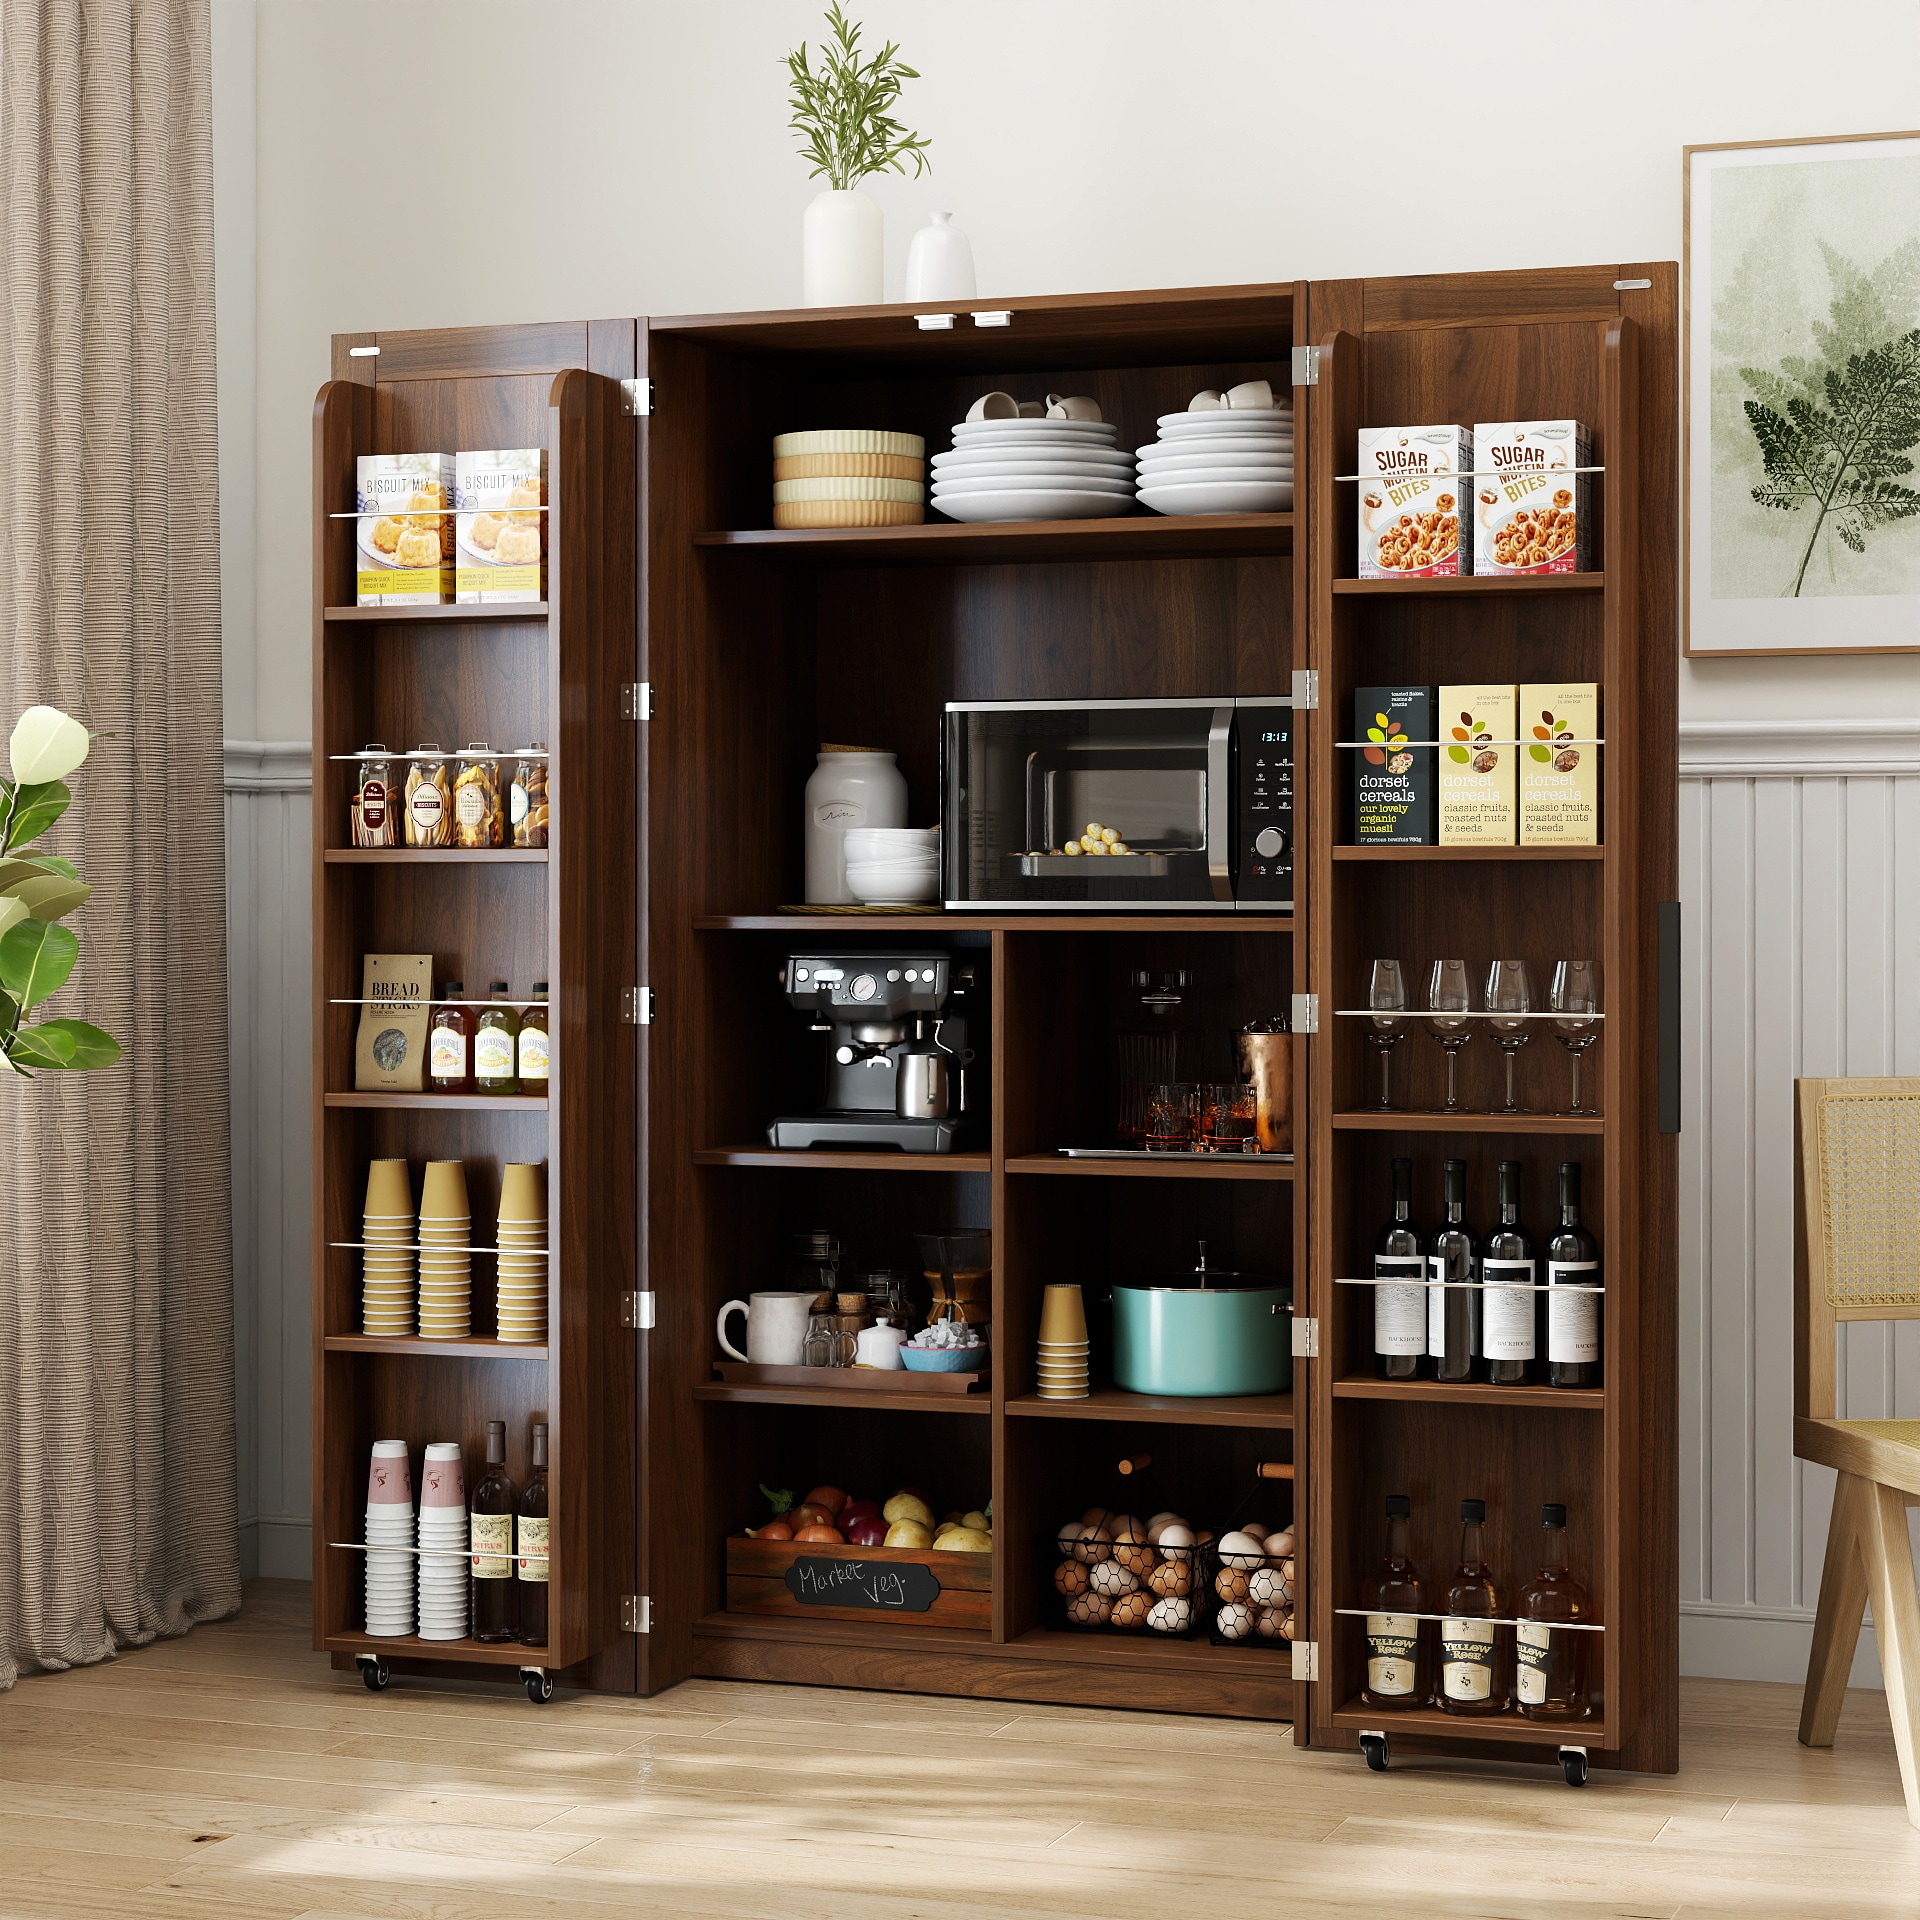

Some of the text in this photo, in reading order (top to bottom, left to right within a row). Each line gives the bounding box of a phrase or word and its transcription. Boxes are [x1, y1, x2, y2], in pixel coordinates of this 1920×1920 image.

[1375, 450, 1428, 471] SUGAR
[1491, 446, 1544, 467] SUGAR
[367, 477, 430, 494] BISCUIT MIX
[466, 473, 530, 490] BISCUIT MIX
[1387, 480, 1430, 507] BITES
[1503, 475, 1546, 503] BITES
[1262, 732, 1287, 742] 13:13
[1360, 775, 1410, 788] dorset
[1444, 774, 1494, 787] dorset
[1525, 773, 1575, 786] dorset
[1360, 788, 1415, 802] cereals
[1444, 788, 1500, 801] cereals
[1525, 787, 1581, 801] cereals
[1379, 804, 1408, 814] lovely
[1445, 804, 1510, 813] classic fruits,
[1525, 803, 1592, 813] classic fruits,
[1360, 815, 1397, 824] organic
[1444, 814, 1506, 822] roasted nuts
[1525, 813, 1588, 822] roasted nuts
[1360, 824, 1393, 833] muesli
[1444, 824, 1482, 833] & seeds
[1525, 823, 1563, 832] & seeds
[371, 982, 420, 996] BREAD
[799, 1562, 865, 1595] Market
[1368, 1637, 1417, 1648] YELLOW
[1443, 1642, 1492, 1654] YELLOW
[1377, 1646, 1406, 1655] ROSE
[1453, 1651, 1482, 1660] ROSE
